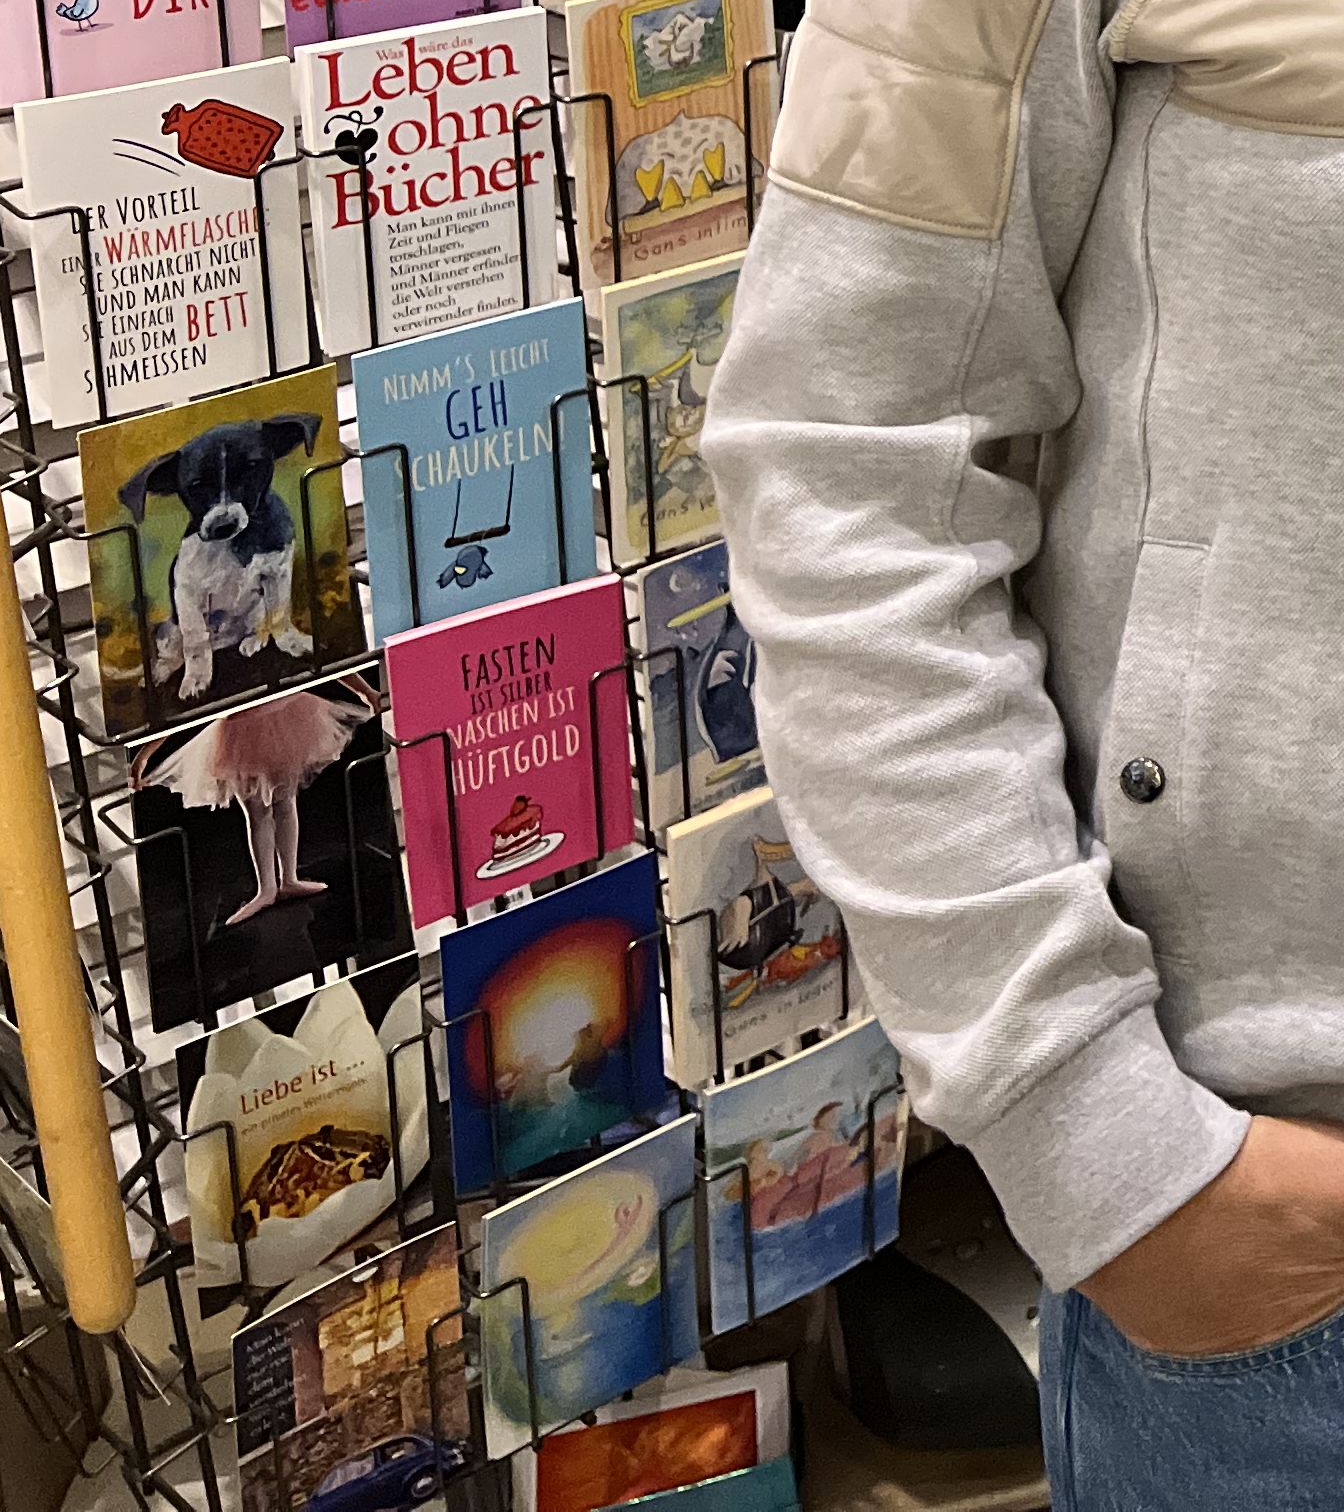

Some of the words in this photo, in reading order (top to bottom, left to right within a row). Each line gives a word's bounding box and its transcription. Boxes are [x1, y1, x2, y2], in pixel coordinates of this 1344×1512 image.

[318, 36, 521, 113] Leben
[376, 48, 404, 63] Was
[418, 38, 449, 54] wäre
[452, 35, 474, 49] das
[387, 91, 545, 156] ohne
[115, 185, 202, 227] VORTEIL
[325, 145, 546, 230] Bücher
[386, 220, 418, 237] Man
[420, 212, 454, 229] kann
[480, 199, 517, 216] ihnen
[388, 235, 414, 250] Zeit
[415, 228, 442, 244] und
[444, 218, 491, 237] Fliegen
[111, 248, 203, 290] SCHNARCHT
[208, 237, 257, 268] NICHT
[389, 257, 441, 279] Männer
[443, 244, 502, 266] vergessen
[390, 275, 417, 293] und
[419, 265, 470, 284] Männer
[97, 289, 136, 316] UND
[143, 276, 186, 304] MAN
[192, 264, 242, 297] KANN
[391, 291, 413, 307] die
[413, 285, 444, 301] Welt
[445, 271, 506, 292] verstehen
[391, 304, 424, 321] oder
[424, 294, 458, 312] noch
[108, 336, 137, 360] AUS
[141, 328, 177, 354] DEM
[185, 291, 249, 343] BETT
[111, 305, 175, 337] EINFACH
[392, 305, 475, 334] verwirrender
[83, 342, 208, 395] SHMEISSEN
[382, 354, 477, 405] NIMM'S
[488, 337, 551, 377] LEICHT
[445, 378, 509, 442] GEH
[460, 632, 557, 693] FASTEN
[449, 699, 541, 751] NASCHEN
[547, 685, 577, 719] IST
[469, 691, 494, 716] IST
[501, 669, 554, 707] SILBER
[450, 723, 581, 797] HÜFTGOLD
[240, 1075, 303, 1115] Liebe
[310, 1059, 338, 1086] ist
